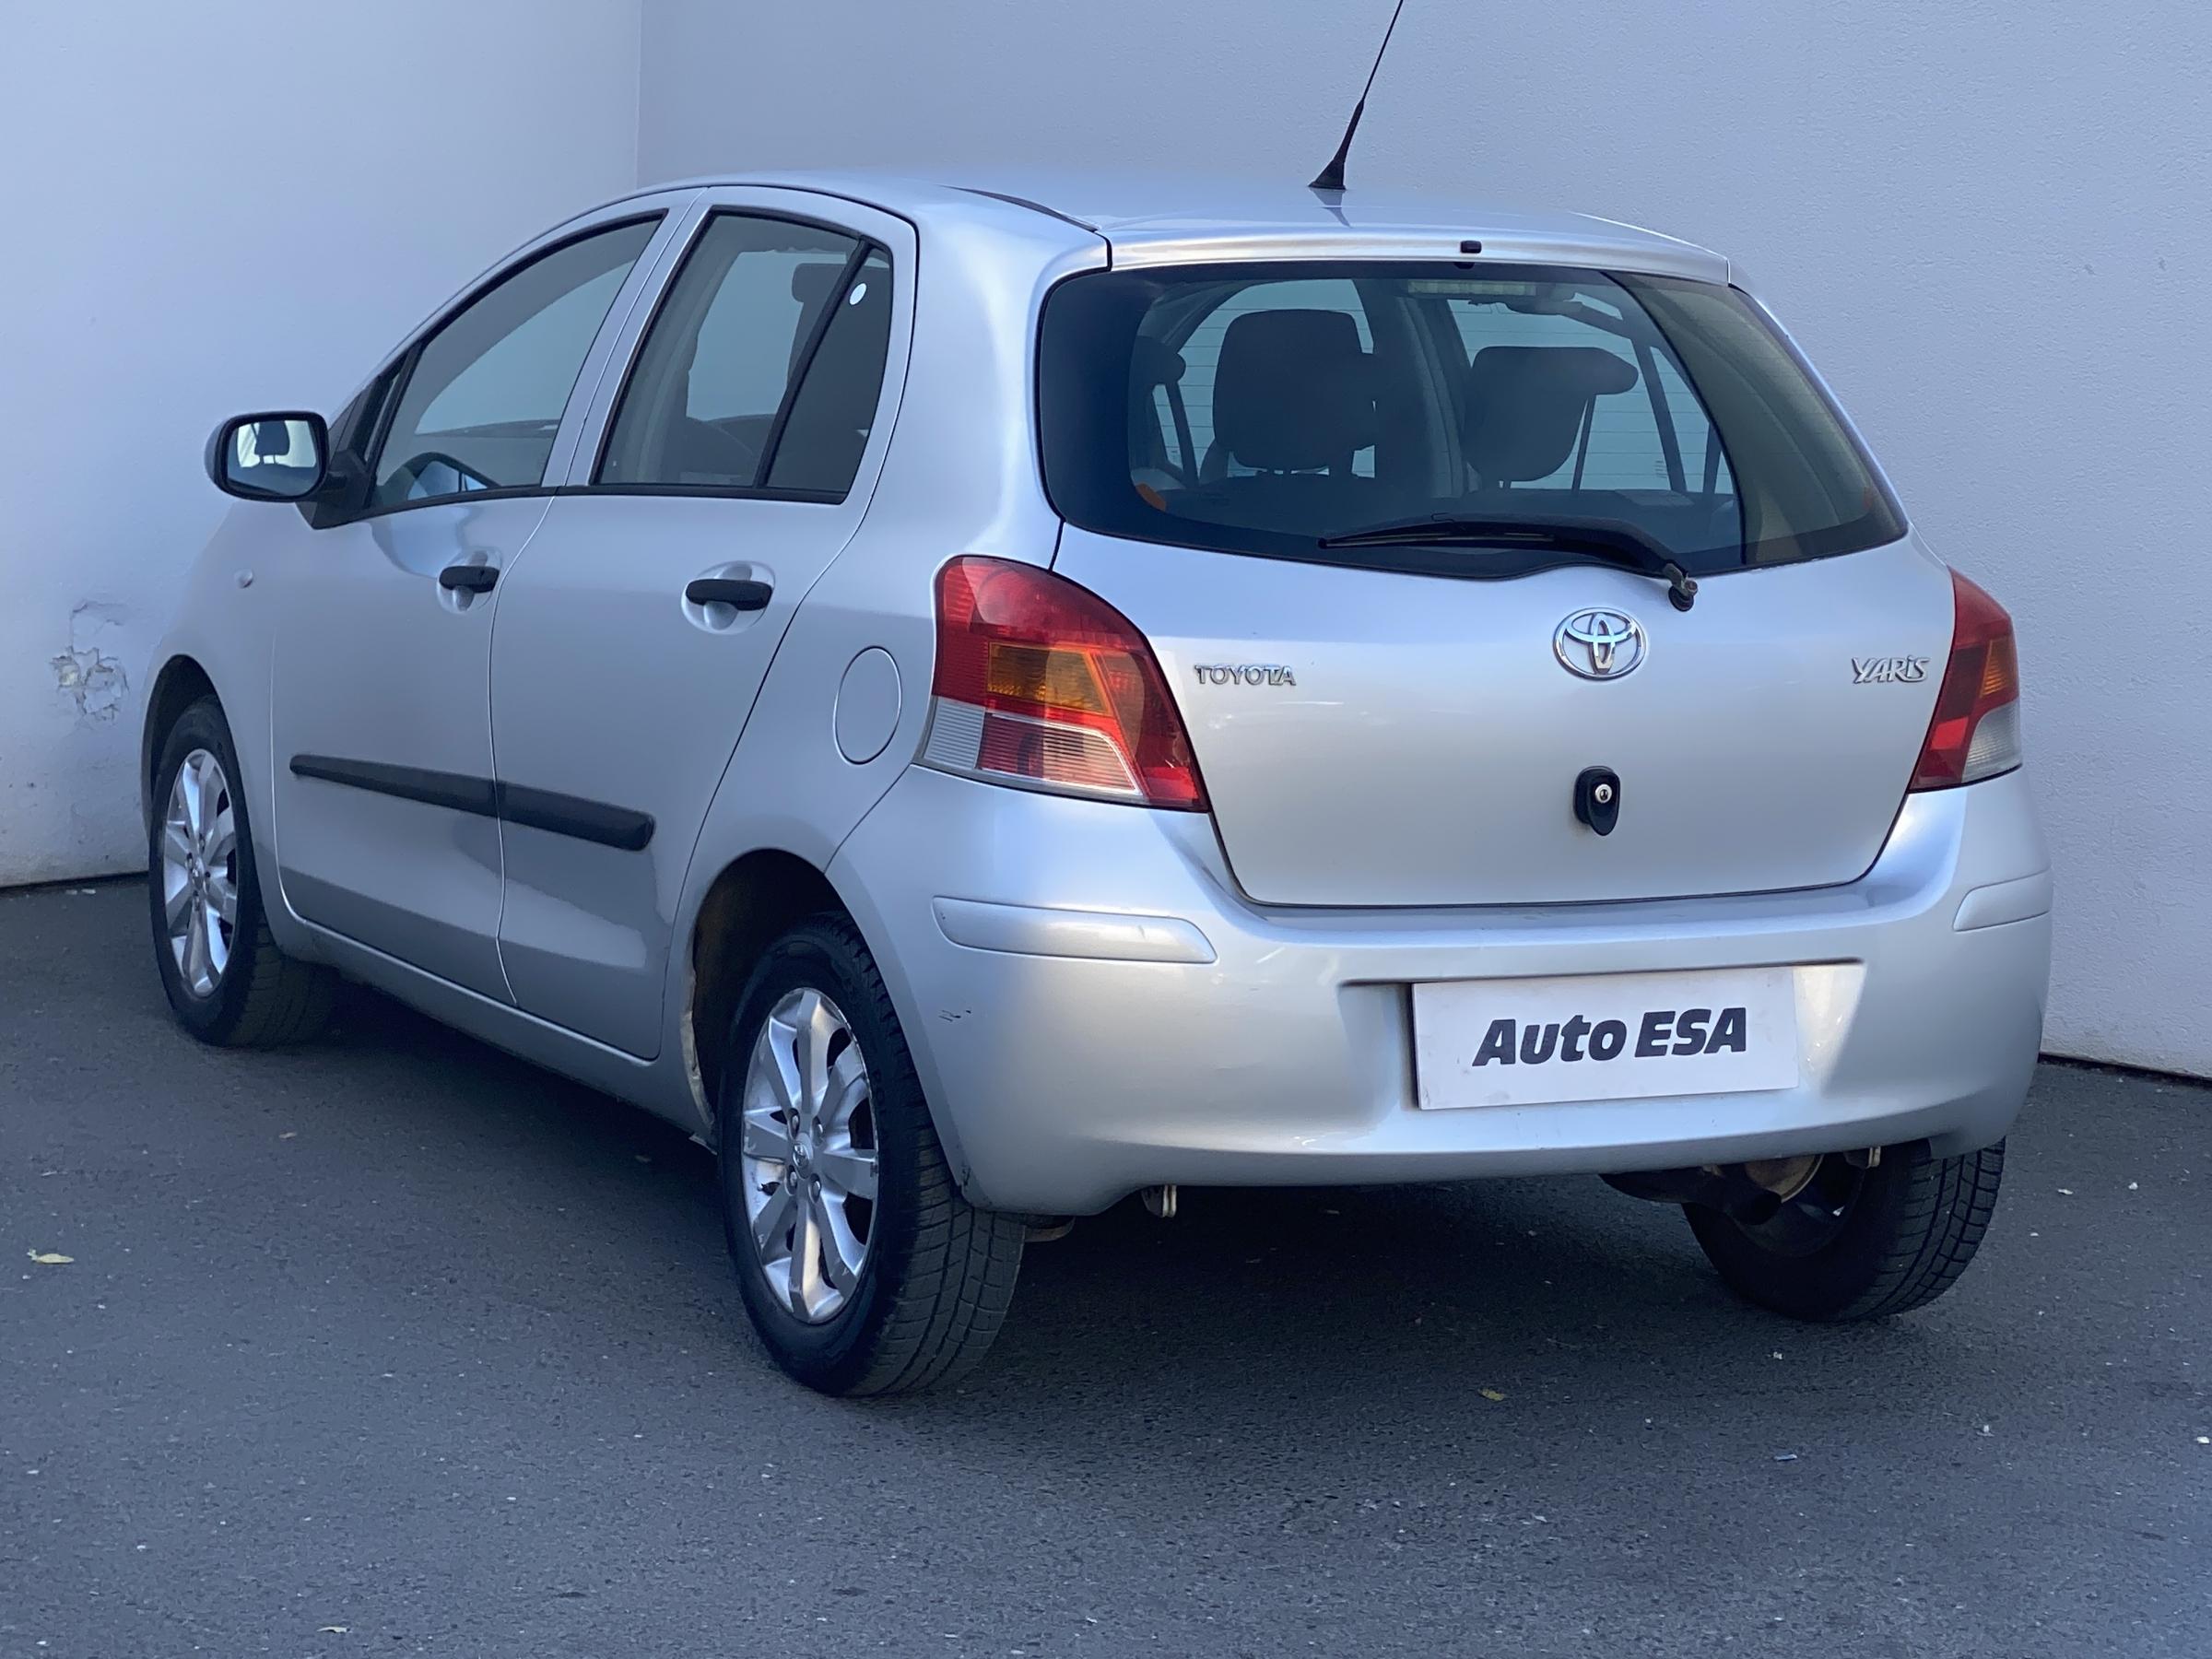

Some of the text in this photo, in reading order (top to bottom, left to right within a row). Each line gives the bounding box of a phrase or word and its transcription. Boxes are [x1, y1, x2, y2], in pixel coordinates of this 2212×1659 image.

[1194, 664, 1296, 686] TOYOTA
[1472, 1007, 1747, 1066] Auto ESA
